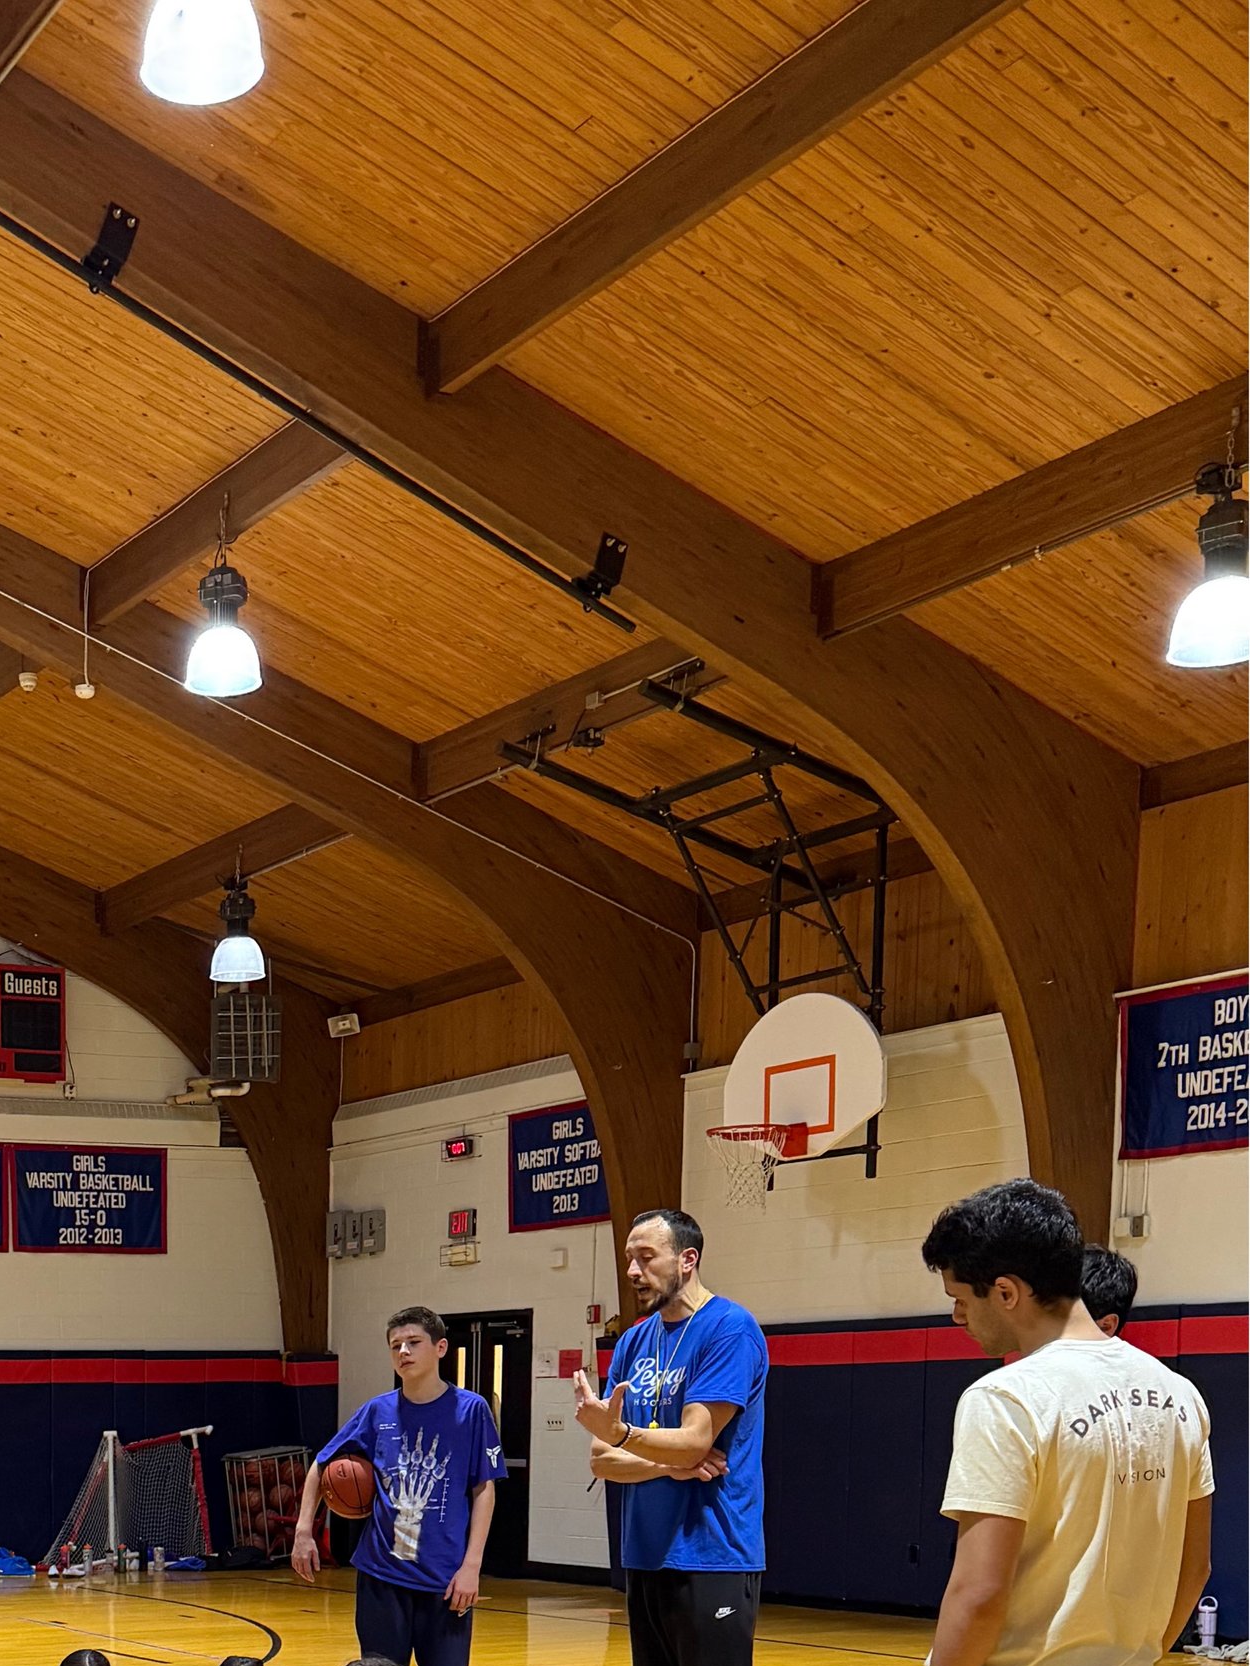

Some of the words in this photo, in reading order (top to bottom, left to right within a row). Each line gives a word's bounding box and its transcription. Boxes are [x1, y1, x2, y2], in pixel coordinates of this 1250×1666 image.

[4, 972, 58, 997] Guests
[1214, 994, 1249, 1026] BOY
[1157, 1041, 1189, 1068] 7TH
[552, 1117, 584, 1140] GIRLS
[73, 1155, 106, 1172] GIRLS
[518, 1146, 560, 1171] VARSITY
[26, 1172, 72, 1189] VARSITY
[79, 1173, 154, 1191] BASKETBALL
[532, 1164, 599, 1192] UNDEFEATED
[53, 1190, 126, 1208] UNDEFEATED
[553, 1193, 579, 1214] 2013
[75, 1209, 106, 1226] 15-0
[452, 1211, 468, 1234] EXIT
[59, 1228, 122, 1245] 2012-2013
[1069, 1389, 1123, 1438] DARK
[1130, 1388, 1187, 1423] SEAS
